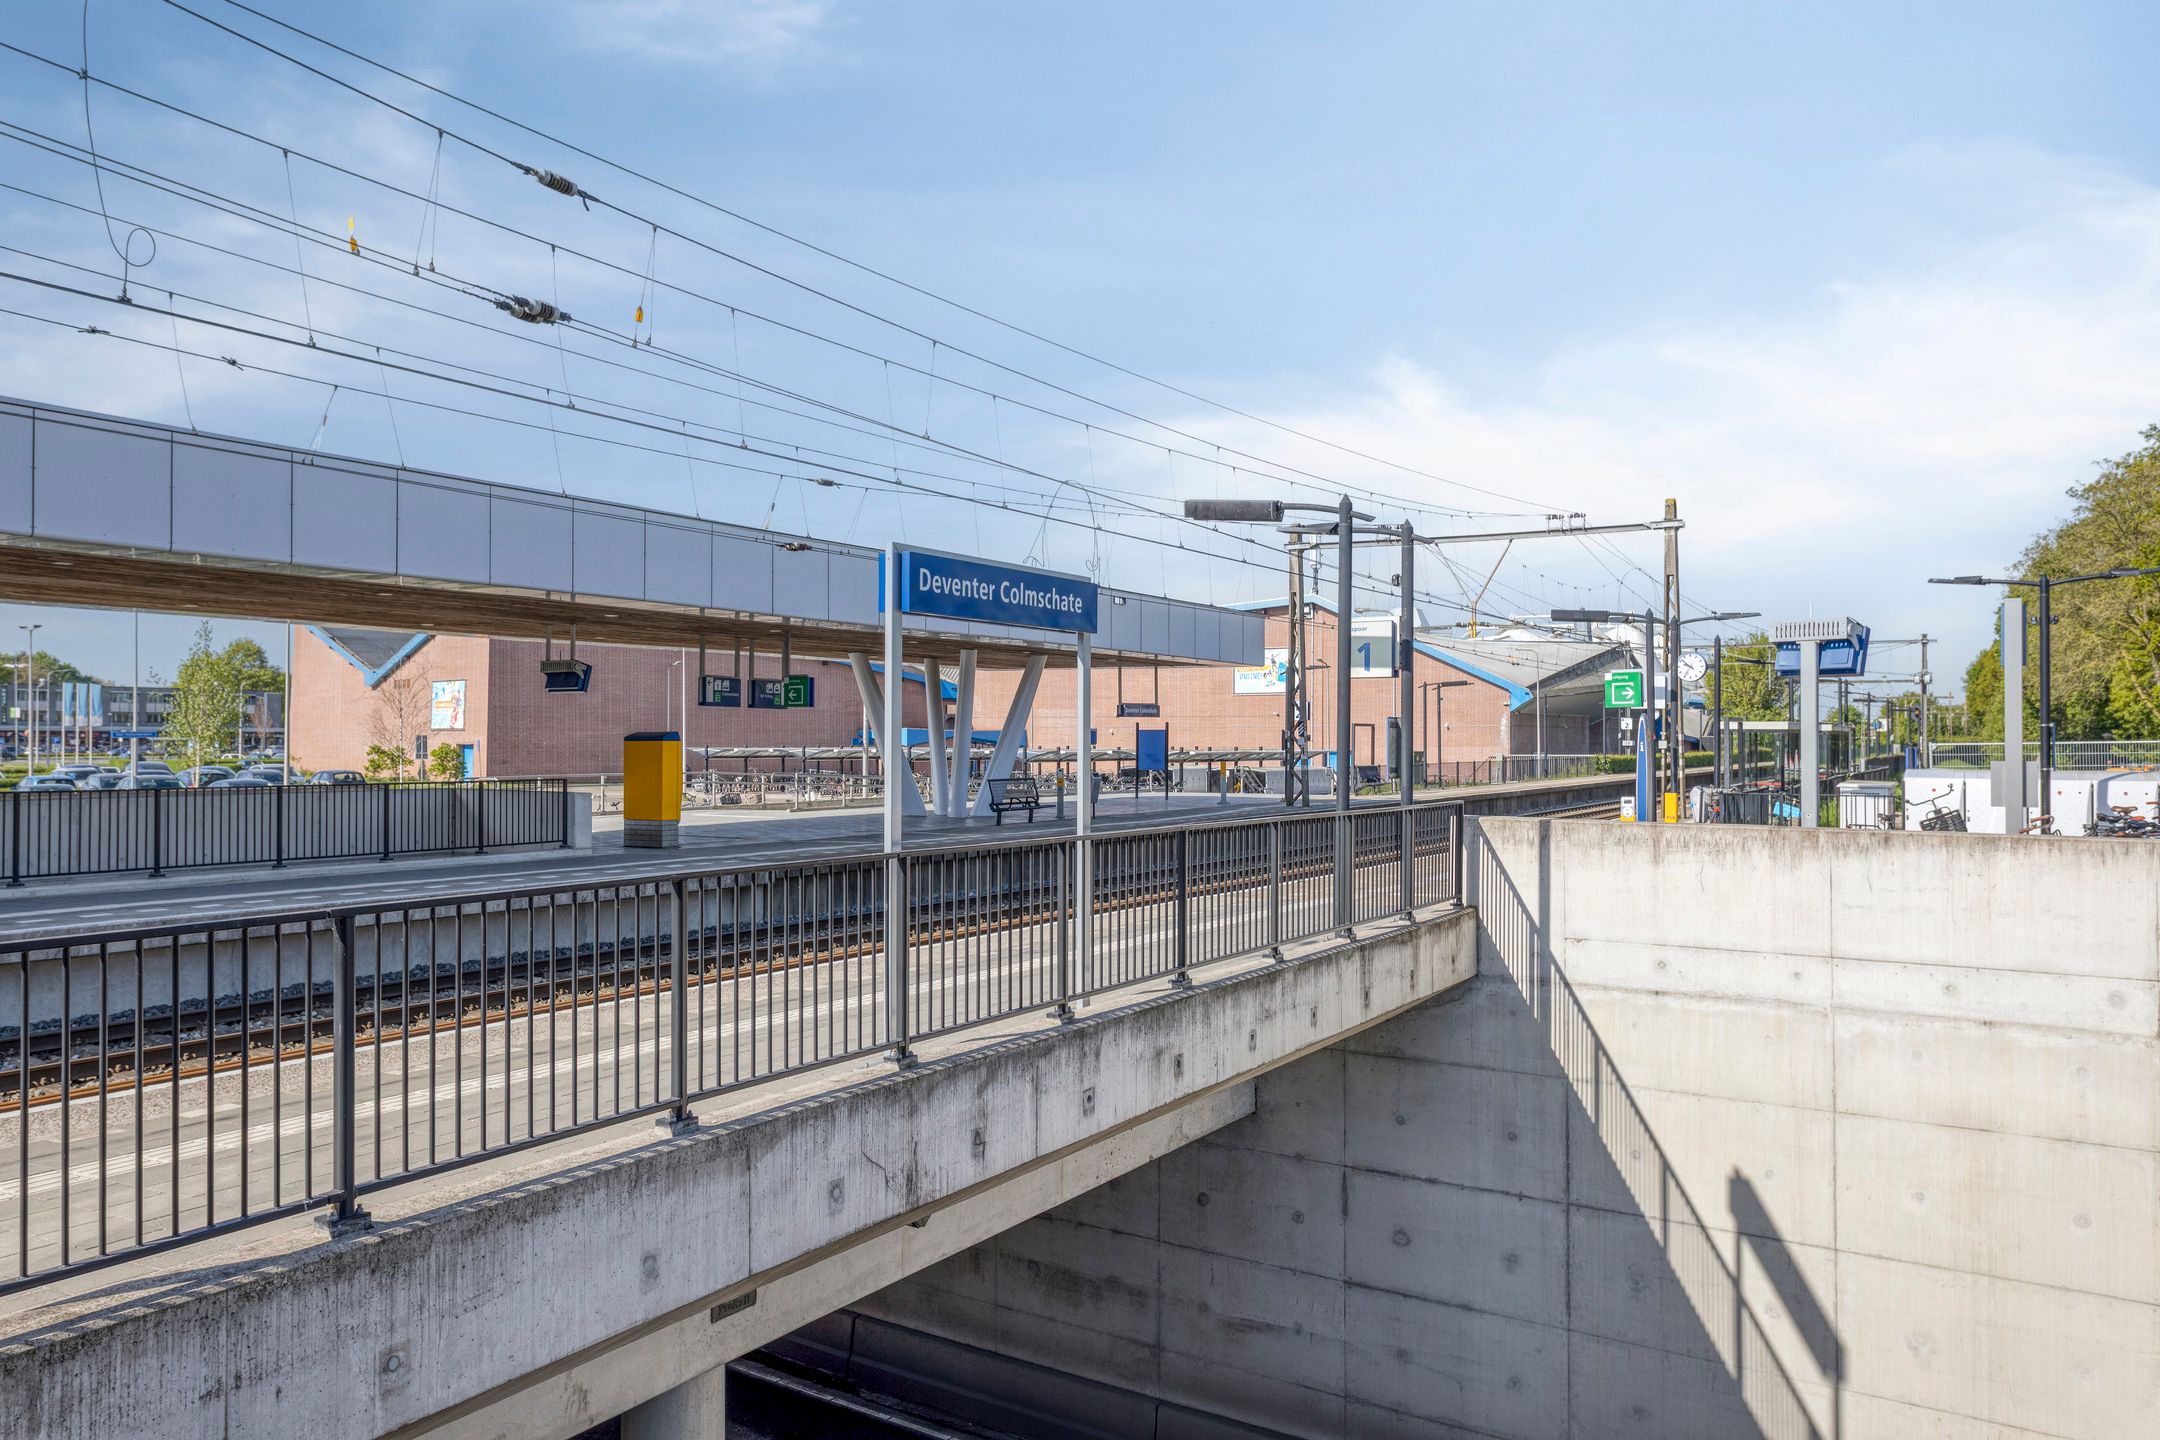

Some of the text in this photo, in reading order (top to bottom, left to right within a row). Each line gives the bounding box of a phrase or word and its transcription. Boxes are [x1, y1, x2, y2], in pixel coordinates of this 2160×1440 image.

[919, 567, 1083, 614] Deventer Colmschate
[1357, 641, 1371, 672] 1
